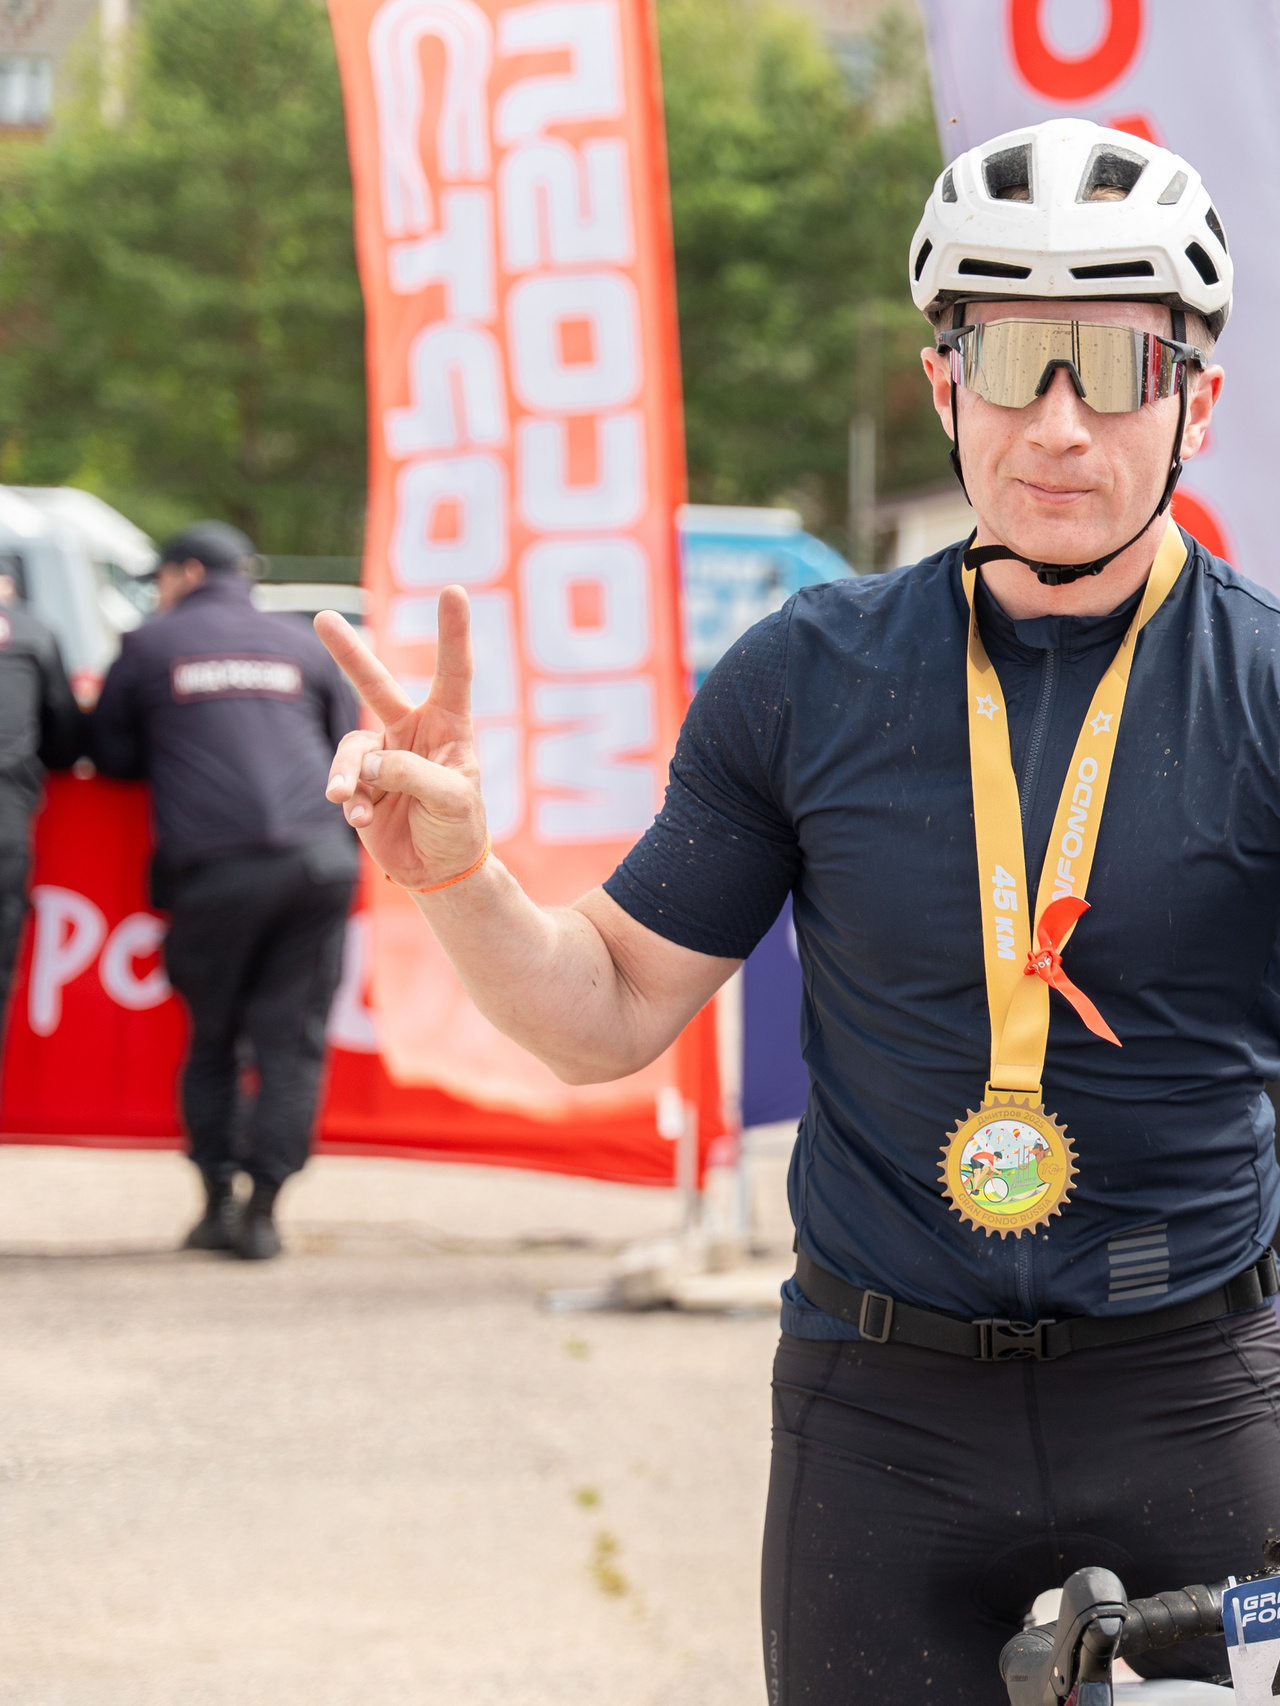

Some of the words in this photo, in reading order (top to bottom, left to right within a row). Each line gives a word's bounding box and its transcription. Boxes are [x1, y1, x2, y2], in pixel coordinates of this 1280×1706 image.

[1051, 756, 1099, 901] NFONDO
[991, 864, 1018, 911] 45
[977, 1110, 1021, 1126] Дмитров
[1023, 1112, 1046, 1128] 2025
[958, 1193, 981, 1217] GRAN
[981, 1213, 1018, 1225] FONDO
[1020, 1199, 1052, 1223] RUSSIA
